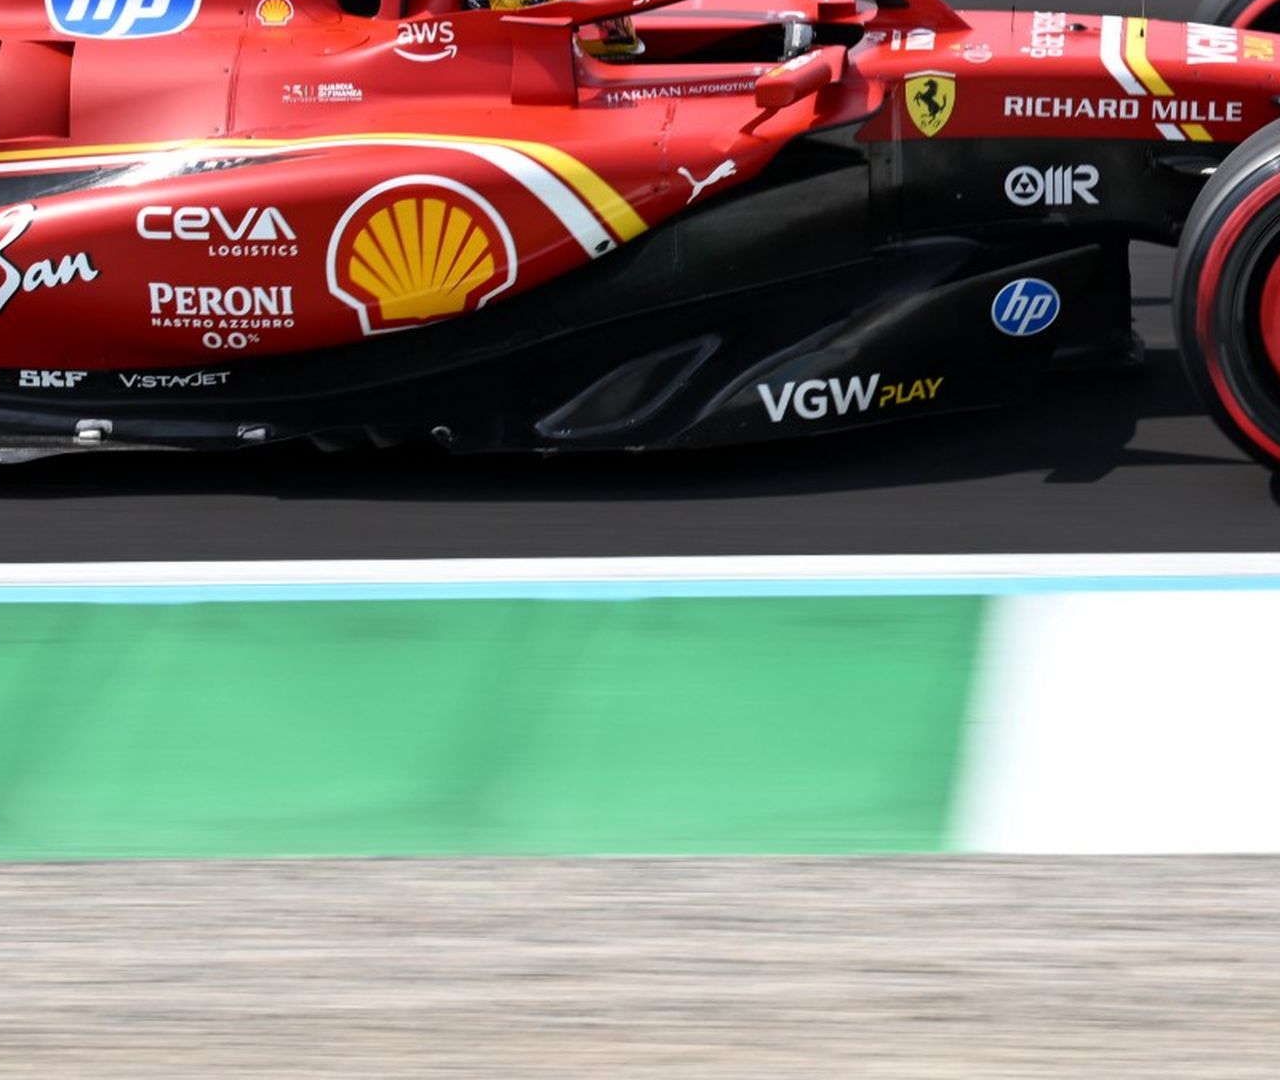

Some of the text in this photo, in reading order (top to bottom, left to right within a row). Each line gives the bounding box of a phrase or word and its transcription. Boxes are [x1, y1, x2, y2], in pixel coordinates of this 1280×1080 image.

[397, 21, 455, 43] aws
[607, 81, 756, 102] HARMAN AUTOMOTIVE
[1004, 96, 1242, 121] RICHARD MILLE
[208, 245, 299, 257] LOGISTICS
[148, 282, 294, 316] PERONI
[1000, 279, 1053, 335] hp
[151, 318, 295, 329] NASTRO AZZURRO
[202, 331, 260, 349] 0.0%
[19, 369, 88, 388] SKF
[757, 373, 944, 423] VGW PLAY
